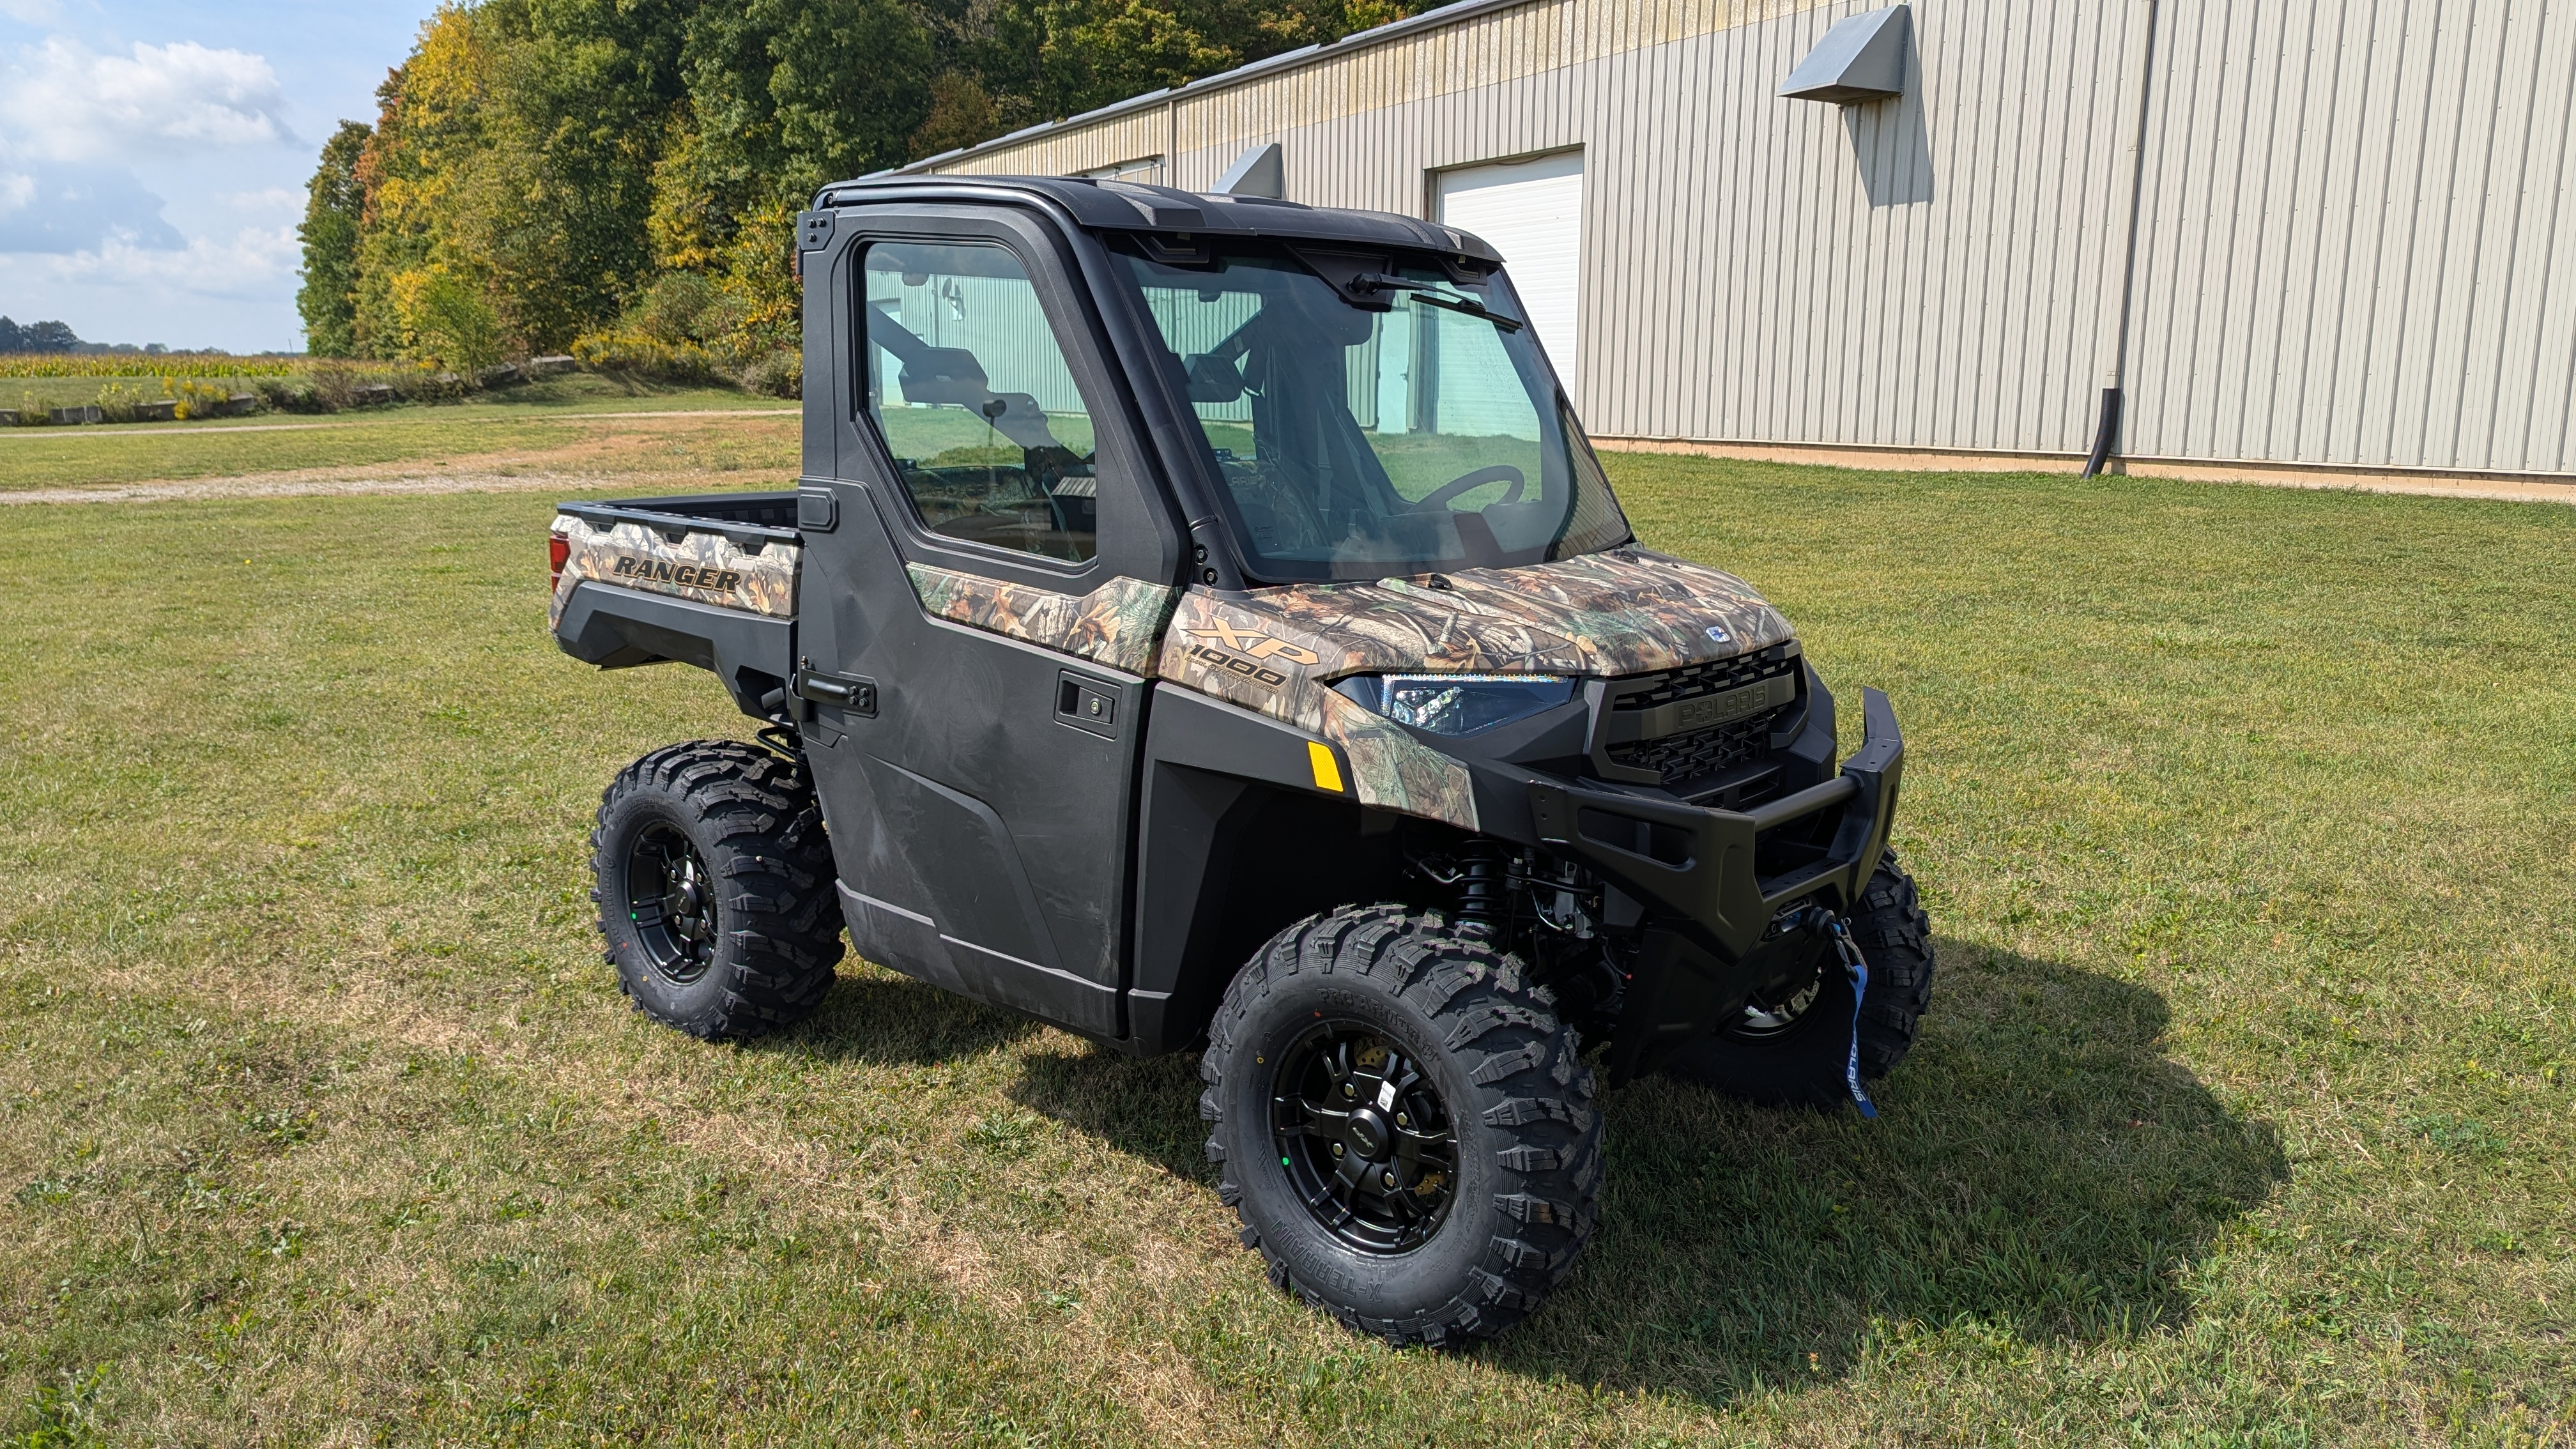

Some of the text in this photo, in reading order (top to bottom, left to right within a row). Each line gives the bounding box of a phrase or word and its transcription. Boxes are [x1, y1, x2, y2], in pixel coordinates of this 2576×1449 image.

[613, 554, 742, 594] RANGER
[1178, 613, 1321, 666] XP
[1189, 643, 1288, 687] 1000
[1678, 685, 1767, 728] POLARIS
[1316, 987, 1355, 1007] PRO
[1269, 1218, 1383, 1303] X-TERRAIN
